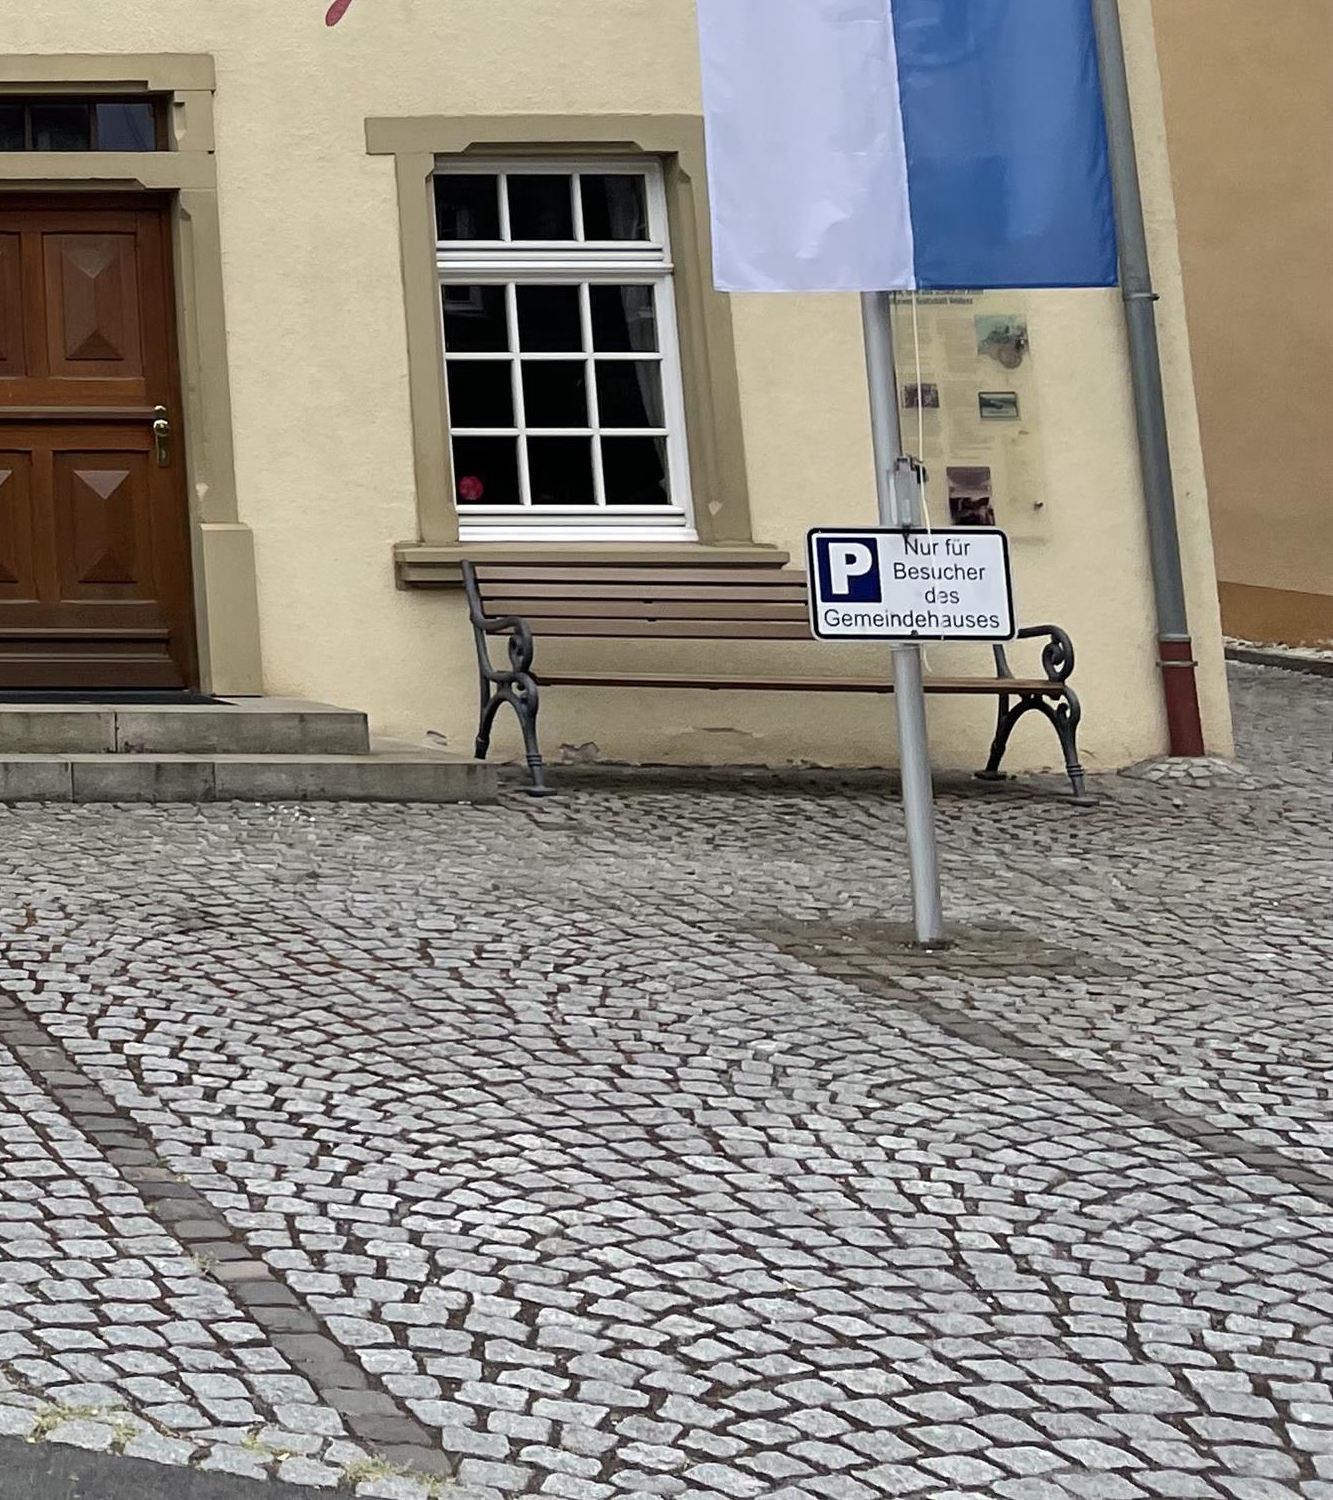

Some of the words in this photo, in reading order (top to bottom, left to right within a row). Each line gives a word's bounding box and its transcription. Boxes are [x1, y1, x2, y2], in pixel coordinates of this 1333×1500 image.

[904, 539, 938, 556] Nur
[945, 538, 971, 556] für
[828, 542, 873, 595] P
[893, 562, 985, 581] Besucher
[924, 586, 960, 604] des
[824, 609, 1000, 628] Gemeindehauses
